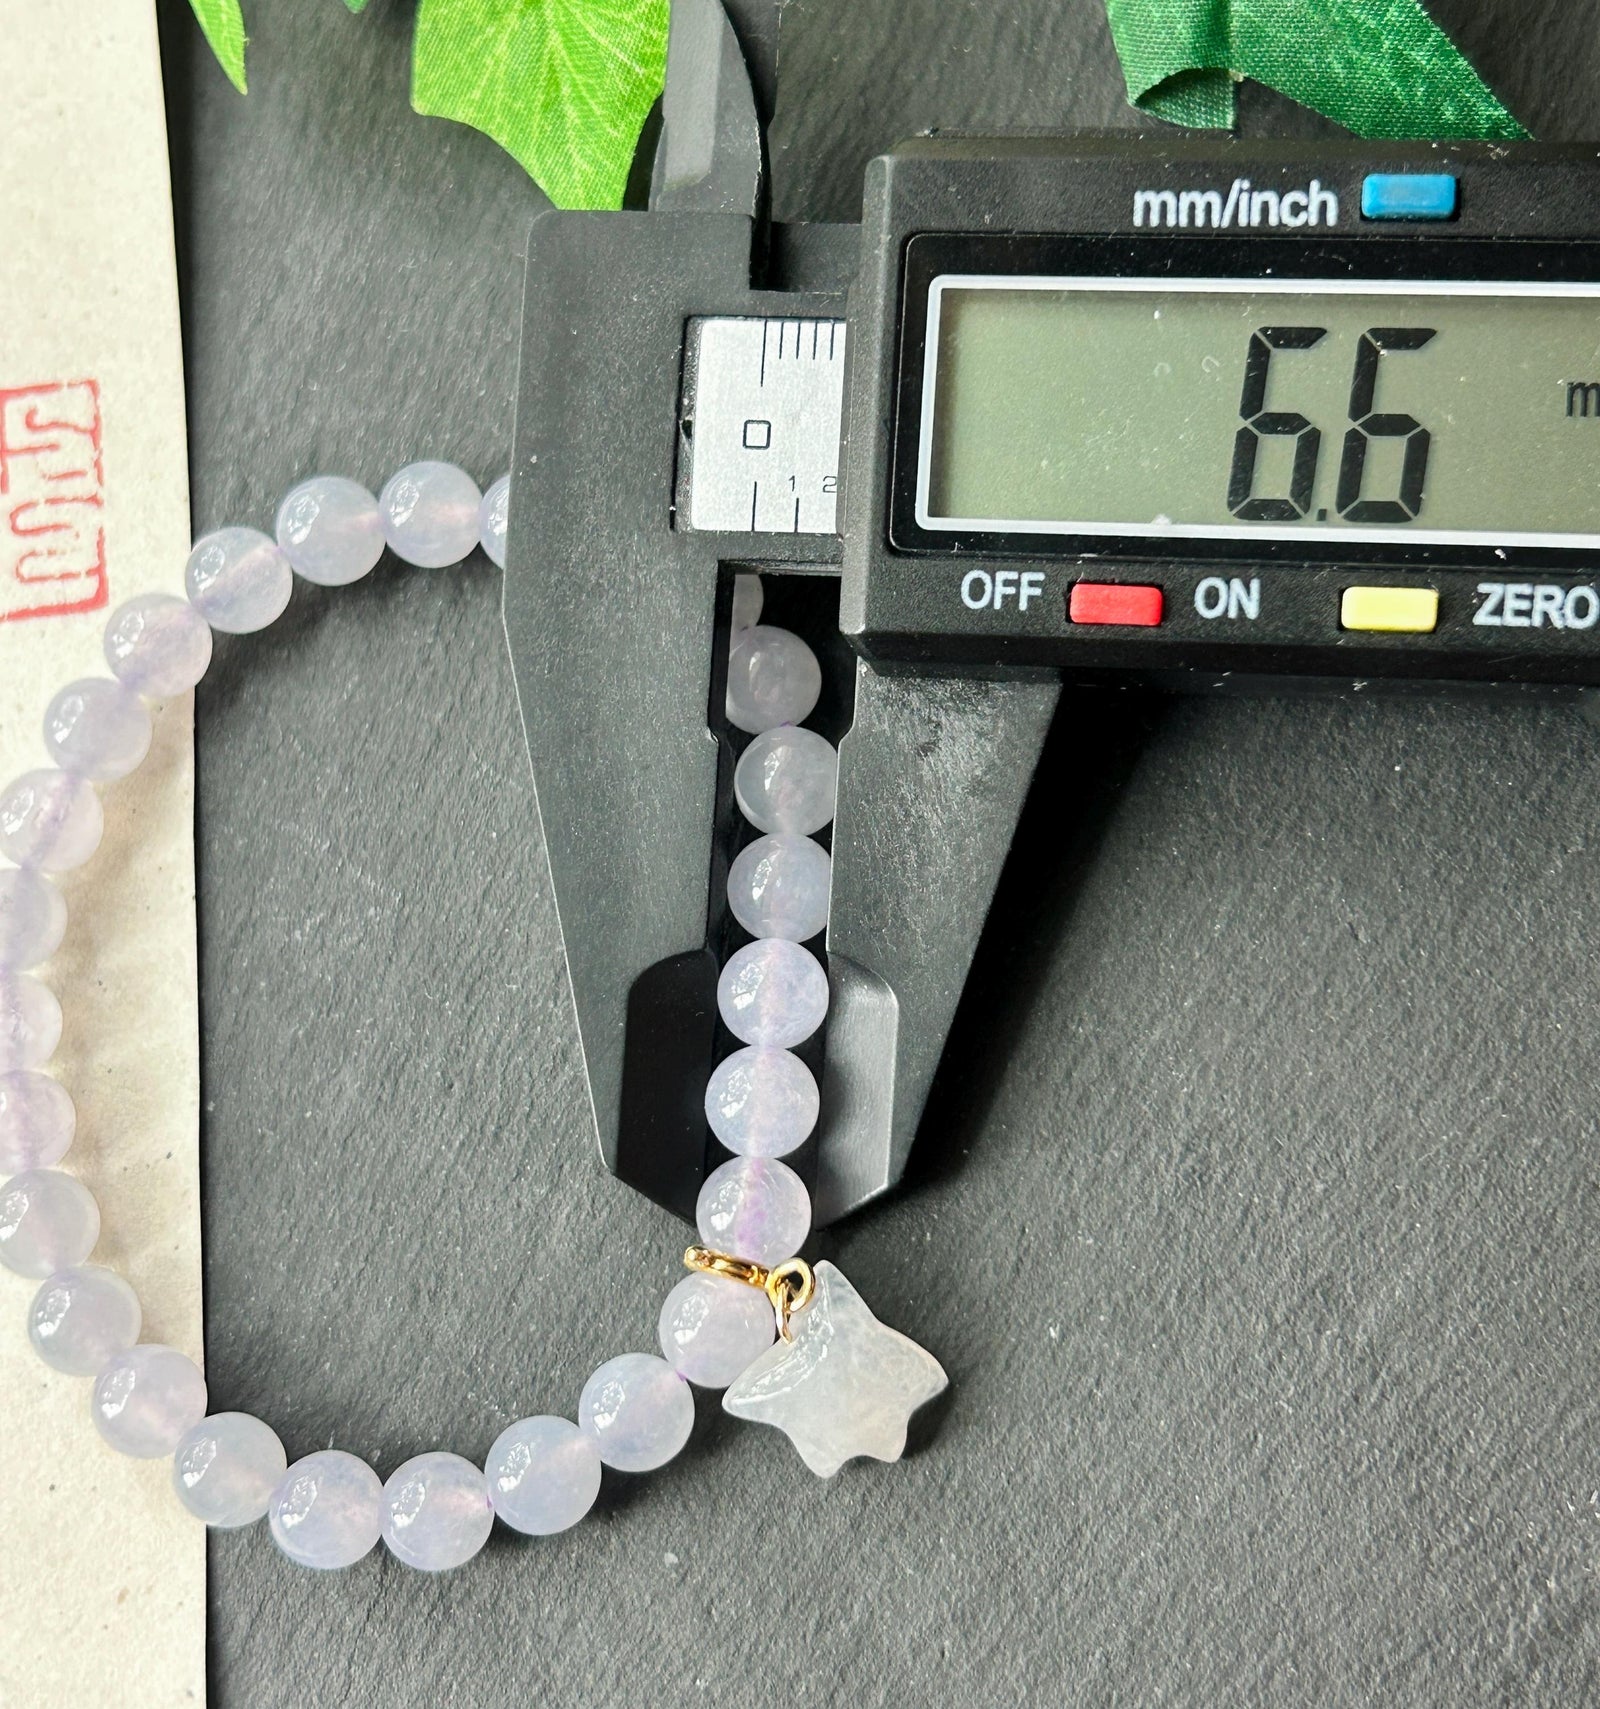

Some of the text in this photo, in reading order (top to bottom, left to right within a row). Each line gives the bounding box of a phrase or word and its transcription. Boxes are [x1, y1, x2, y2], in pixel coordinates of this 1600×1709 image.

[1132, 178, 1339, 229] mm/inch
[1227, 326, 1438, 523] 6.6
[788, 474, 838, 494] 1 2
[960, 569, 1046, 611] OFF
[1194, 576, 1261, 620] ON
[1472, 582, 1600, 630] ZERO
